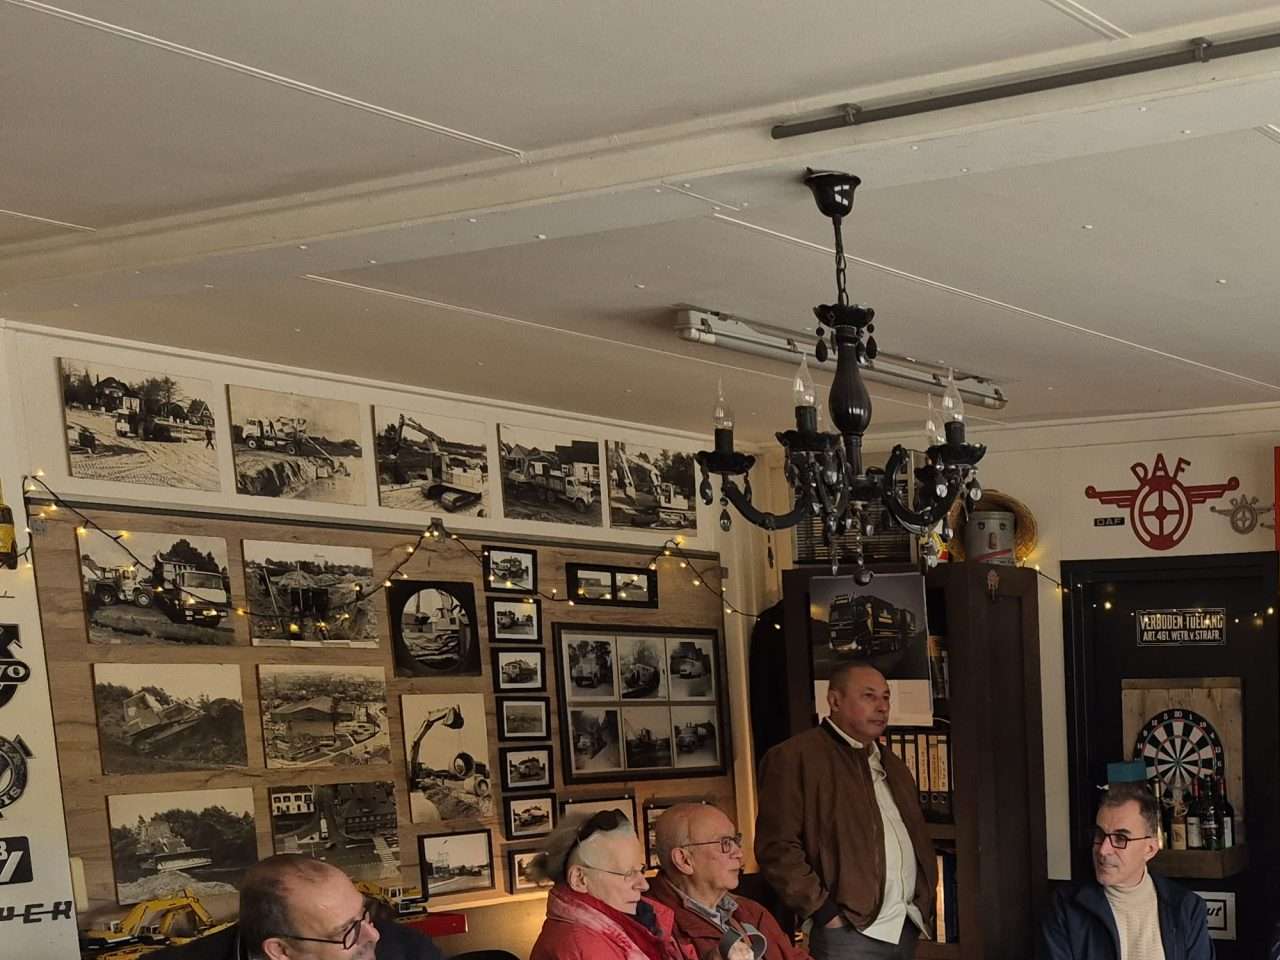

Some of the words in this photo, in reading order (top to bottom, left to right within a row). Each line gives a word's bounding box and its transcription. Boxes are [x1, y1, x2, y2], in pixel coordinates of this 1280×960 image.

[1130, 453, 1192, 482] DAF
[1096, 518, 1123, 526] DAF
[1140, 614, 1183, 630] VERBODEN
[1184, 613, 1224, 629] TOEGANG
[1195, 630, 1221, 640] STRAFR.
